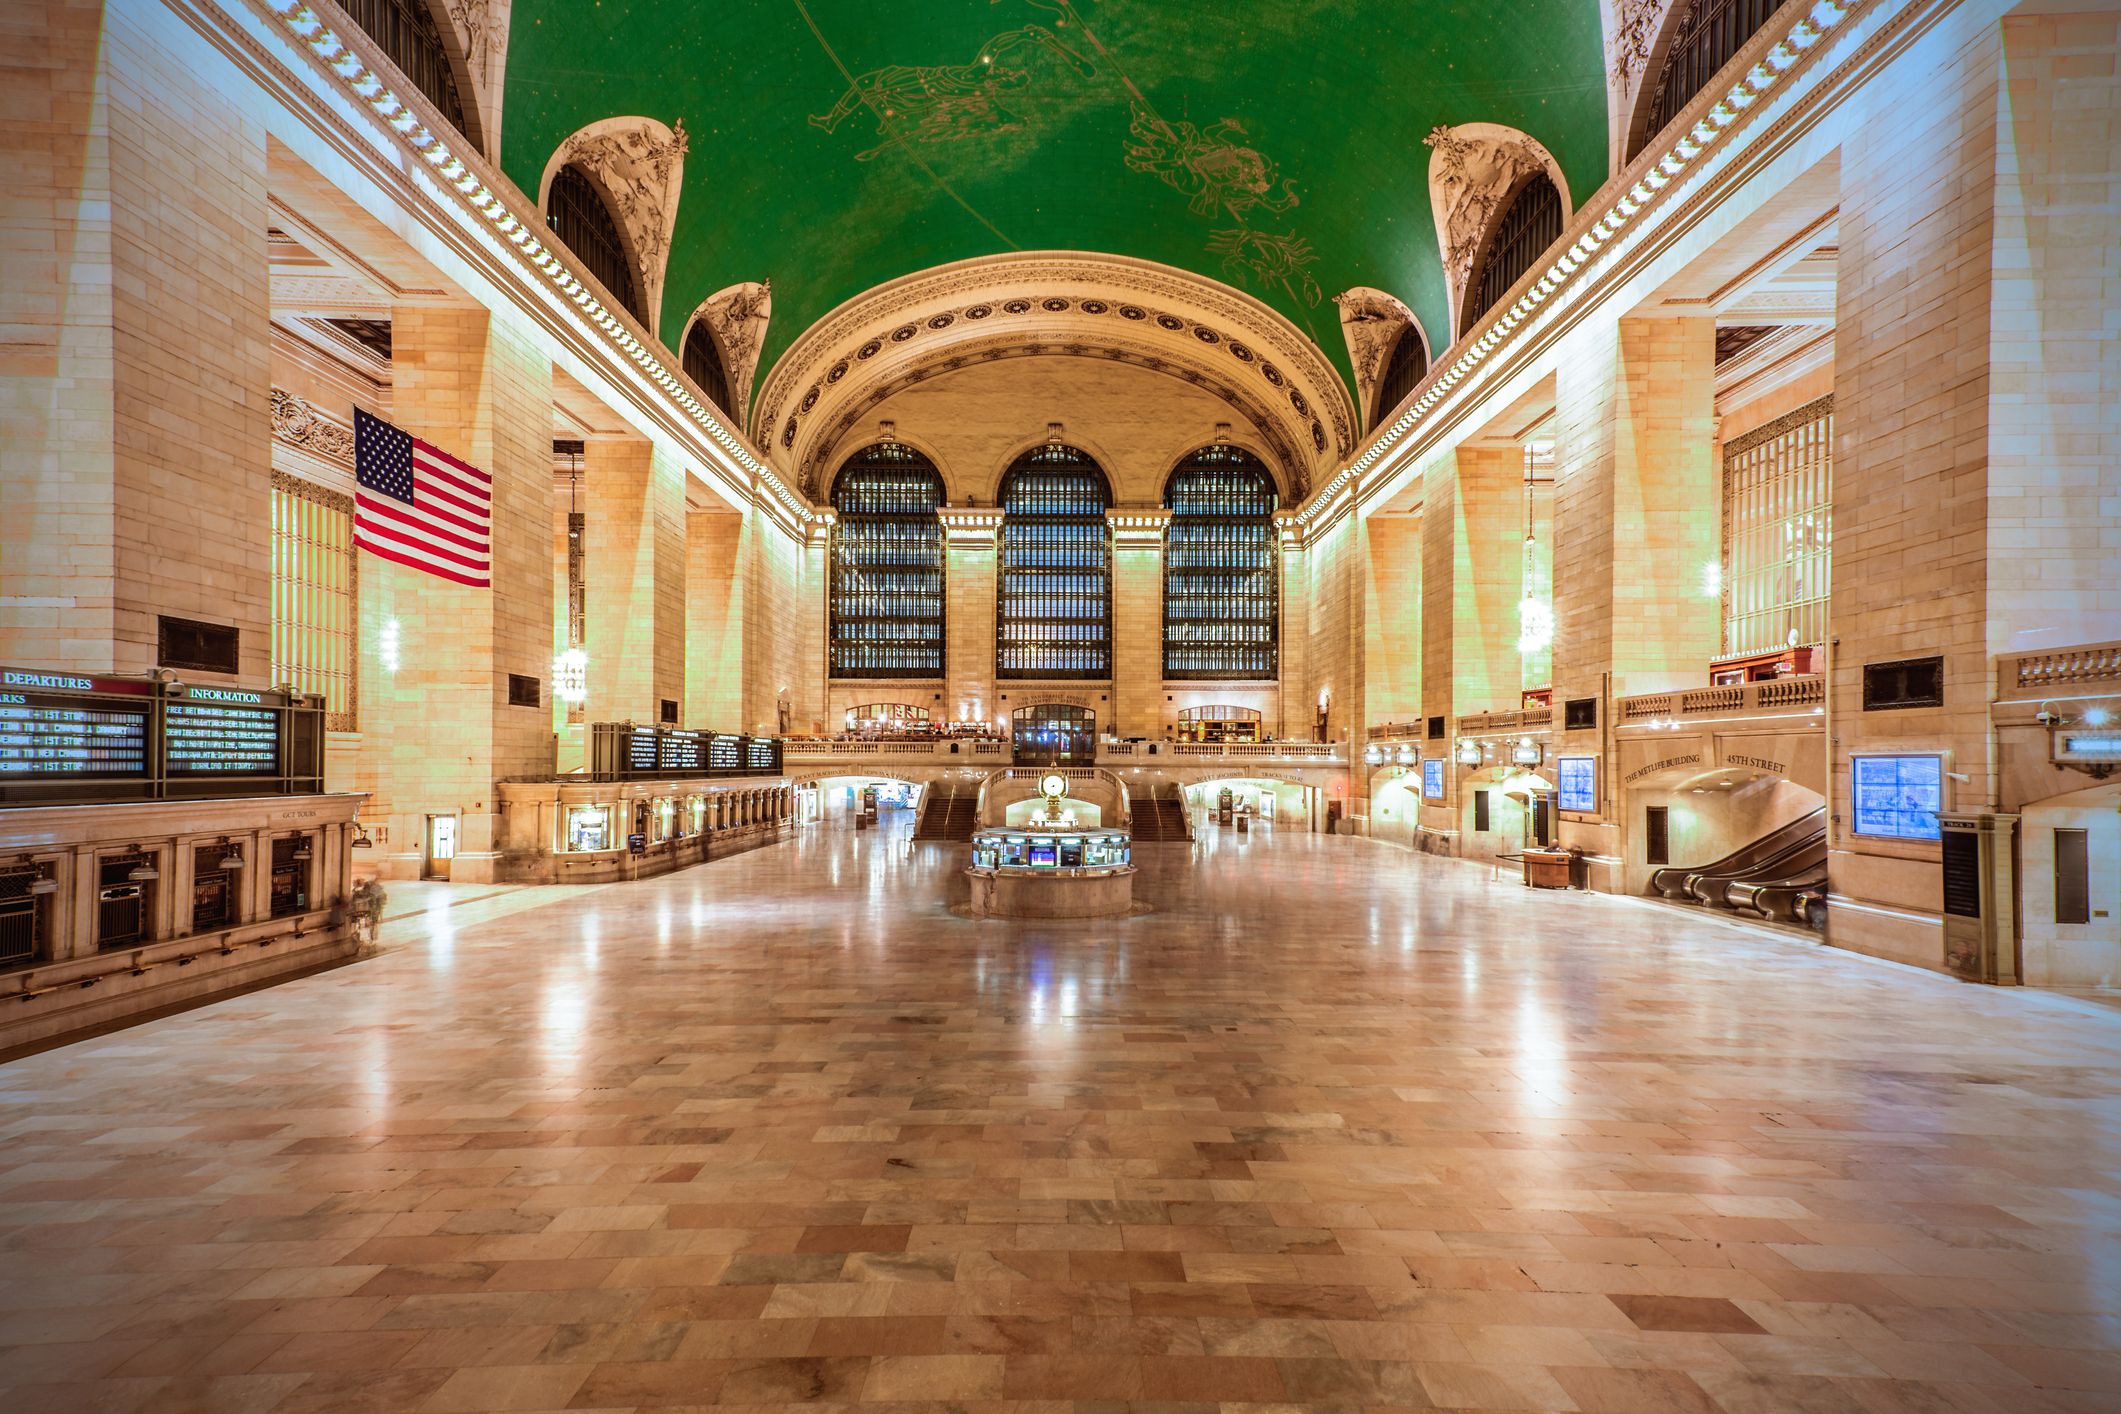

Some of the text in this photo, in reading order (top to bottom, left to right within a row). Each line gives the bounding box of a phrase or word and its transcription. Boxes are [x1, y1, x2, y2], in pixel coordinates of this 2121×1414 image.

[4, 672, 92, 689] DEPARTURES
[189, 688, 260, 703] INFORMATION
[1624, 754, 1700, 784] THE METLIFE BUILDING
[1726, 754, 1786, 774] 45TH STREET
